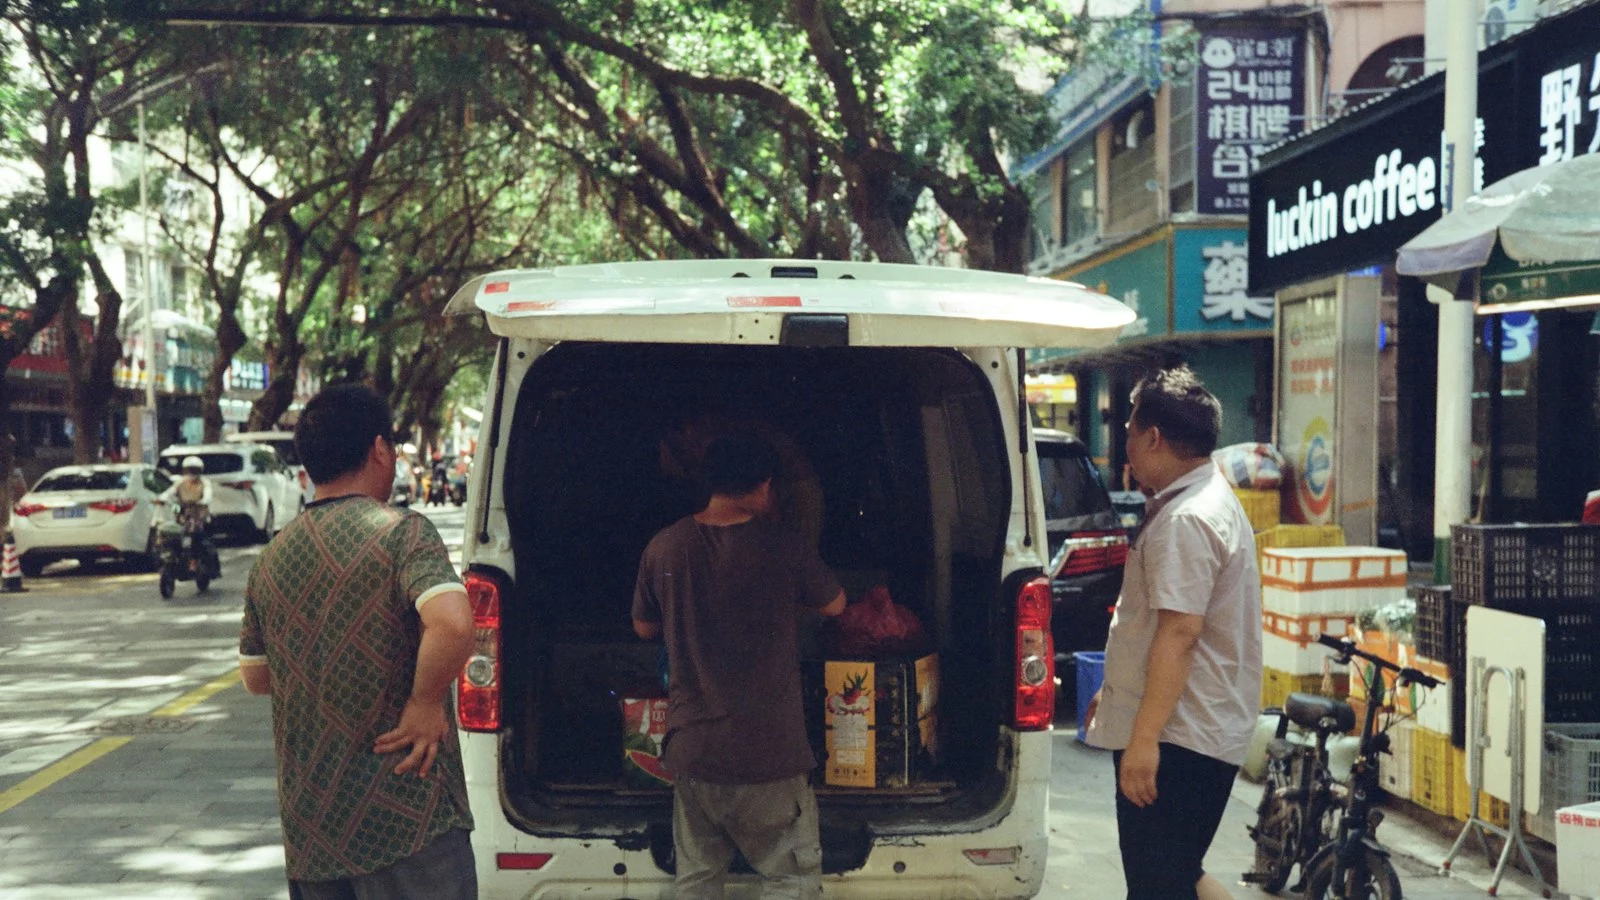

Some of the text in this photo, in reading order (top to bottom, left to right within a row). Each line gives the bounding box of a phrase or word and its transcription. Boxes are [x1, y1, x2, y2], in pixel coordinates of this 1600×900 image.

[1208, 70, 1256, 99] 24
[1208, 105, 1289, 139] 棋牌
[1267, 180, 1338, 258] luckin
[1343, 148, 1436, 234] coffee
